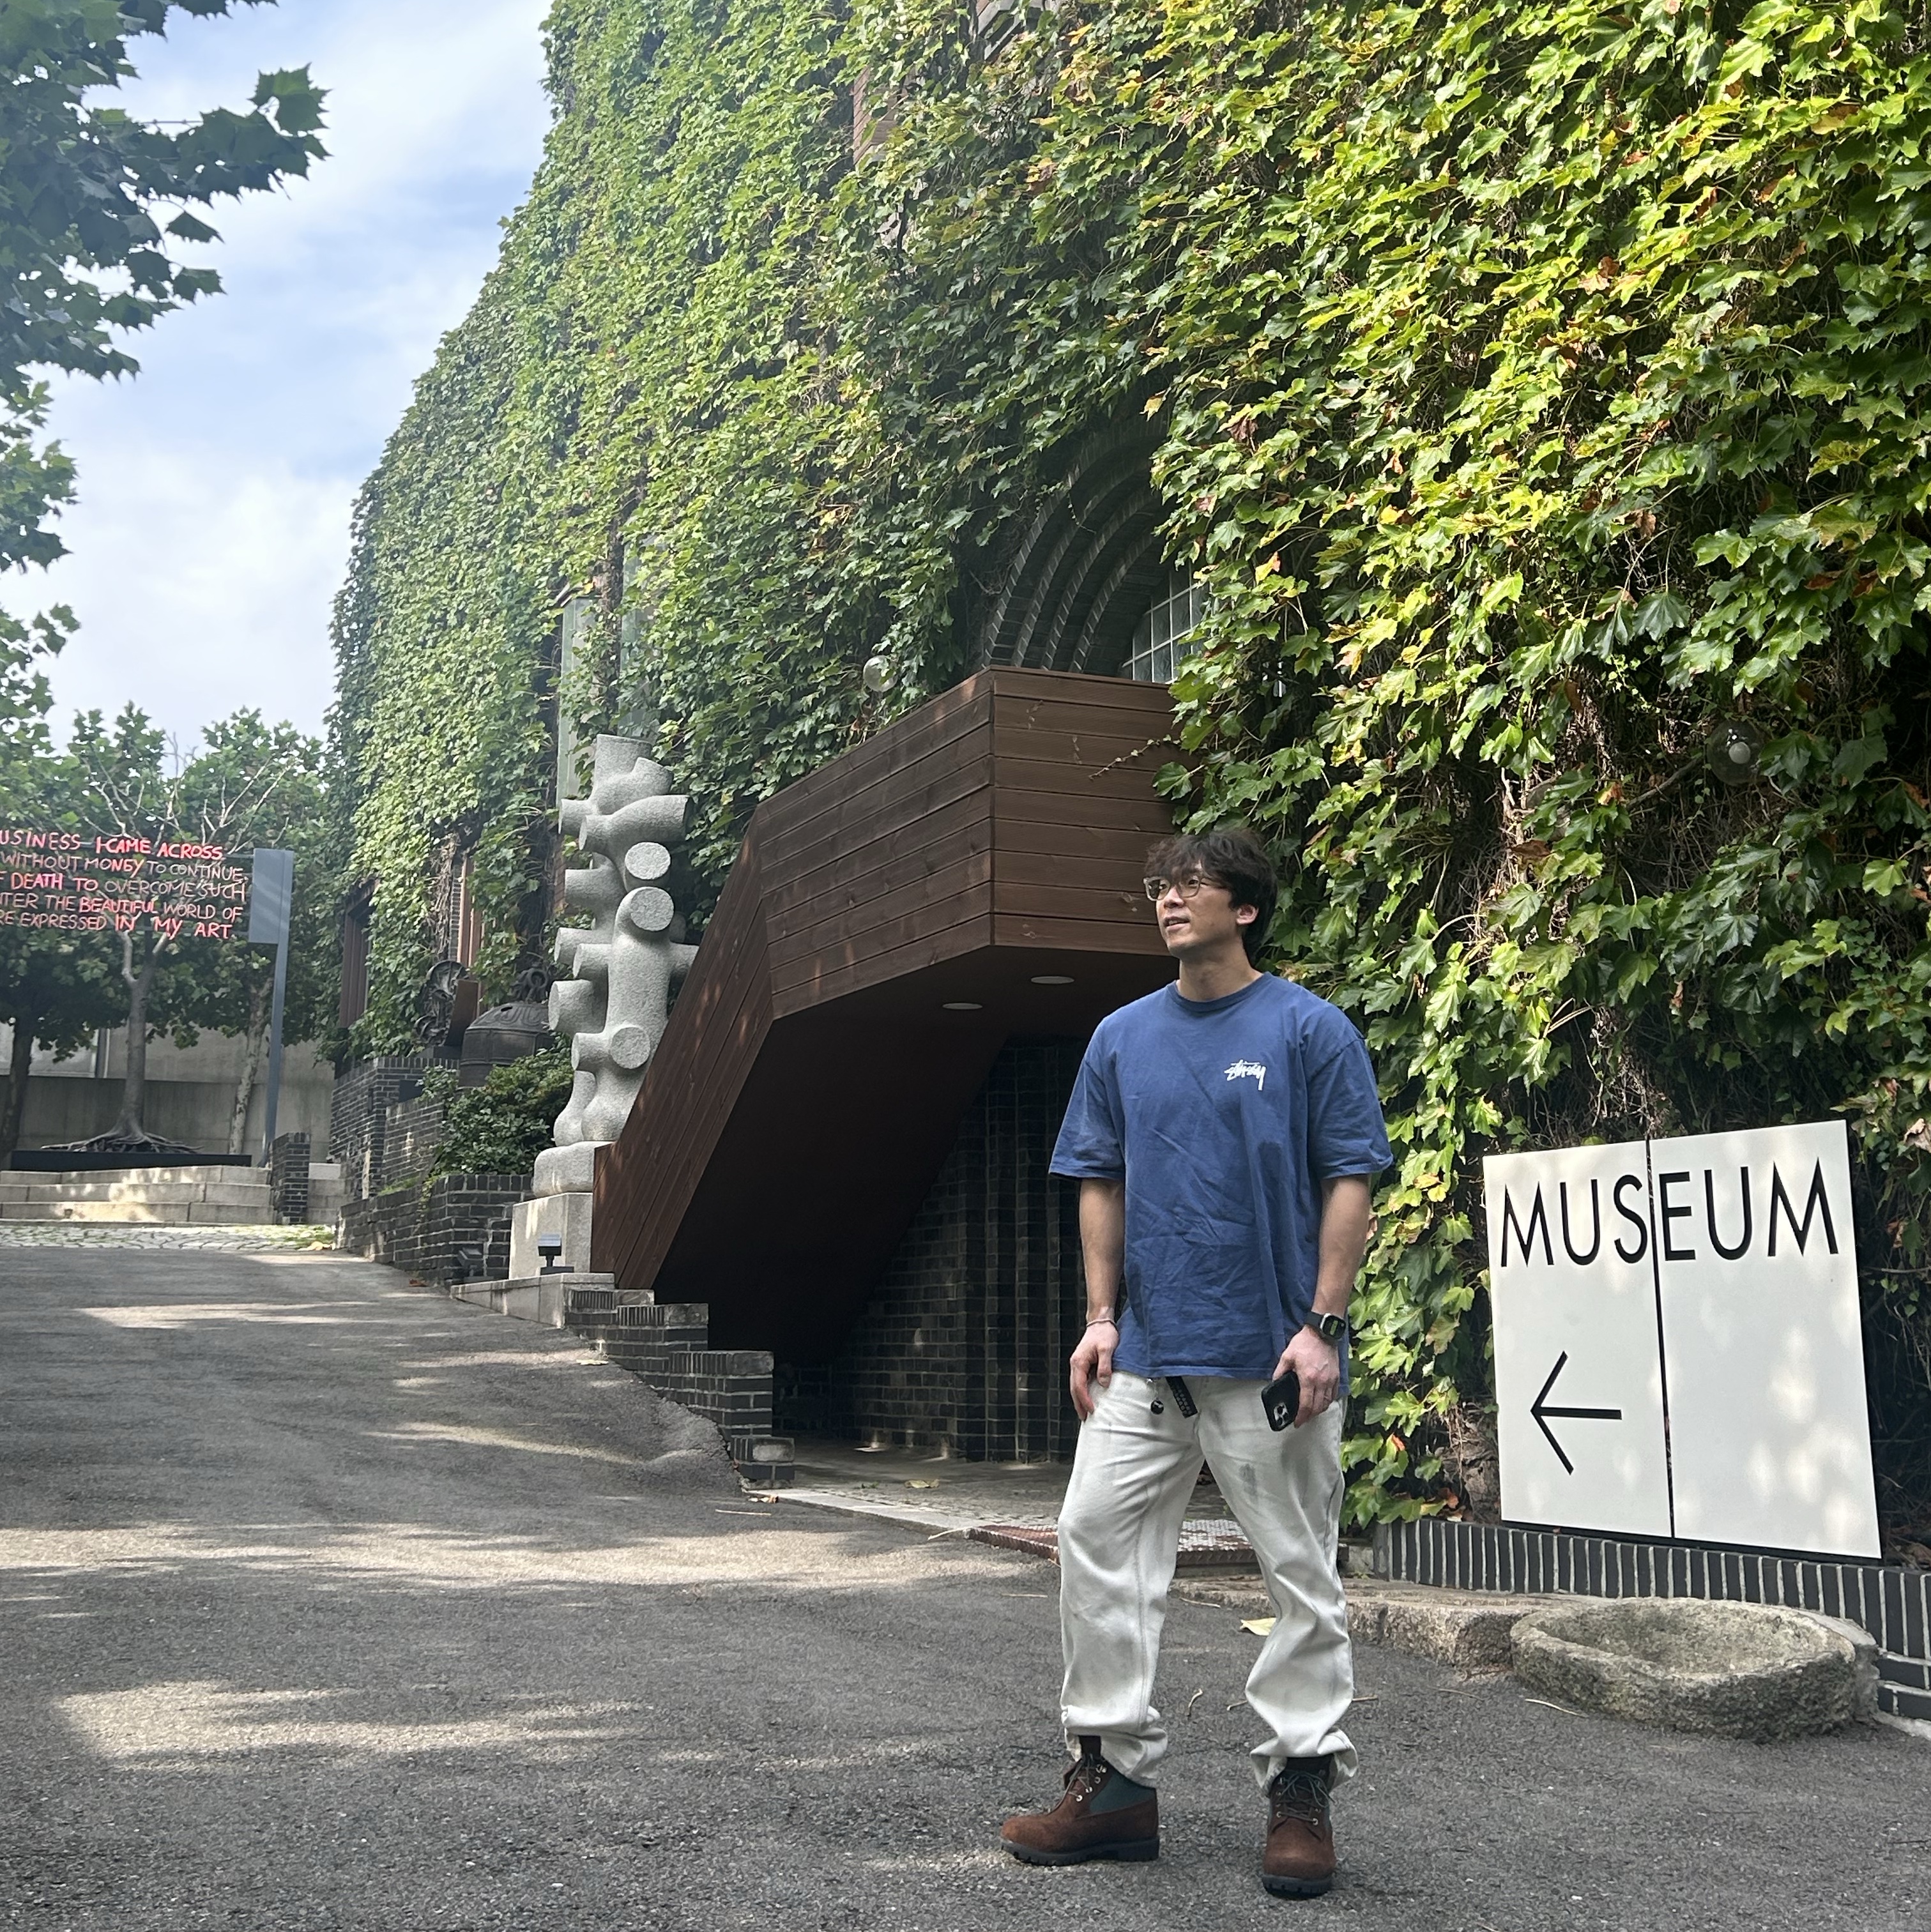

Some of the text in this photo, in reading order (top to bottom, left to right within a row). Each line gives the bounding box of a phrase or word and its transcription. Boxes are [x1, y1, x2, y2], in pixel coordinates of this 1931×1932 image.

[105, 837, 151, 854] CAME
[156, 842, 223, 860] ACROSS
[0, 850, 82, 872] WITHOUT
[84, 856, 145, 878] MONEY
[146, 860, 166, 876] TO
[11, 872, 63, 890] DEATH
[72, 877, 98, 892] TO
[104, 879, 195, 897] OVERCOME
[197, 882, 246, 902] SUCH
[44, 895, 77, 911] THE
[79, 897, 158, 914] BEAUTIFUL
[164, 901, 216, 919] WORLD
[222, 906, 243, 924] OF
[20, 912, 107, 930] EXPRESSED
[114, 913, 135, 932] IN
[153, 916, 183, 940] MY
[194, 922, 233, 939] ART
[1500, 1156, 1838, 1267] MUSEUM
